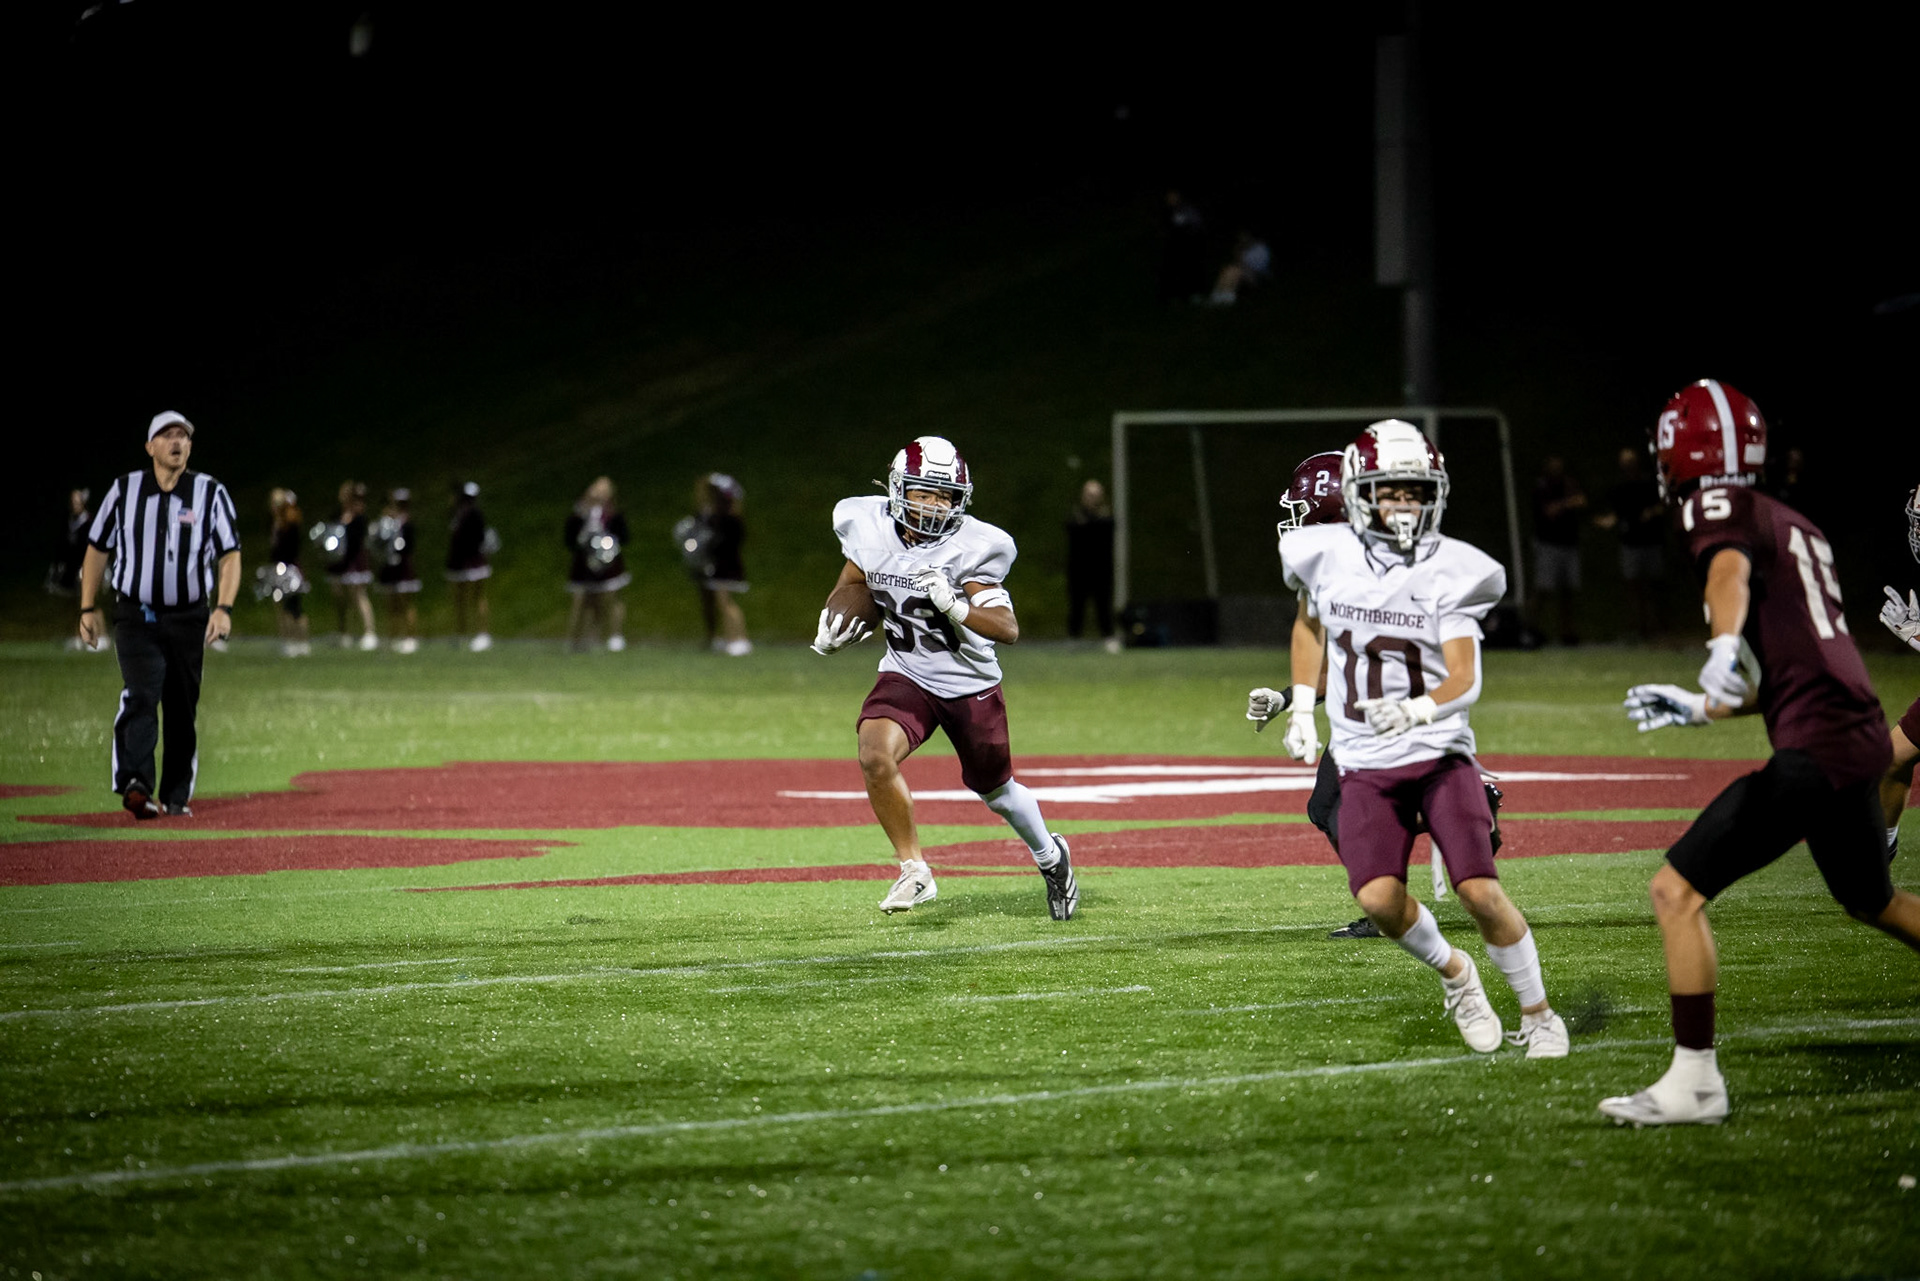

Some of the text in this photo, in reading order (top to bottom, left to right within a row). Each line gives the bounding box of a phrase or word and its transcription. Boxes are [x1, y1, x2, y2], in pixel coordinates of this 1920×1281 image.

[1314, 470, 1331, 497] 2
[1682, 487, 1732, 532] 15
[1788, 525, 1849, 640] 15
[1329, 600, 1426, 629] NORTHBRIDGE
[1334, 629, 1426, 724] 10
